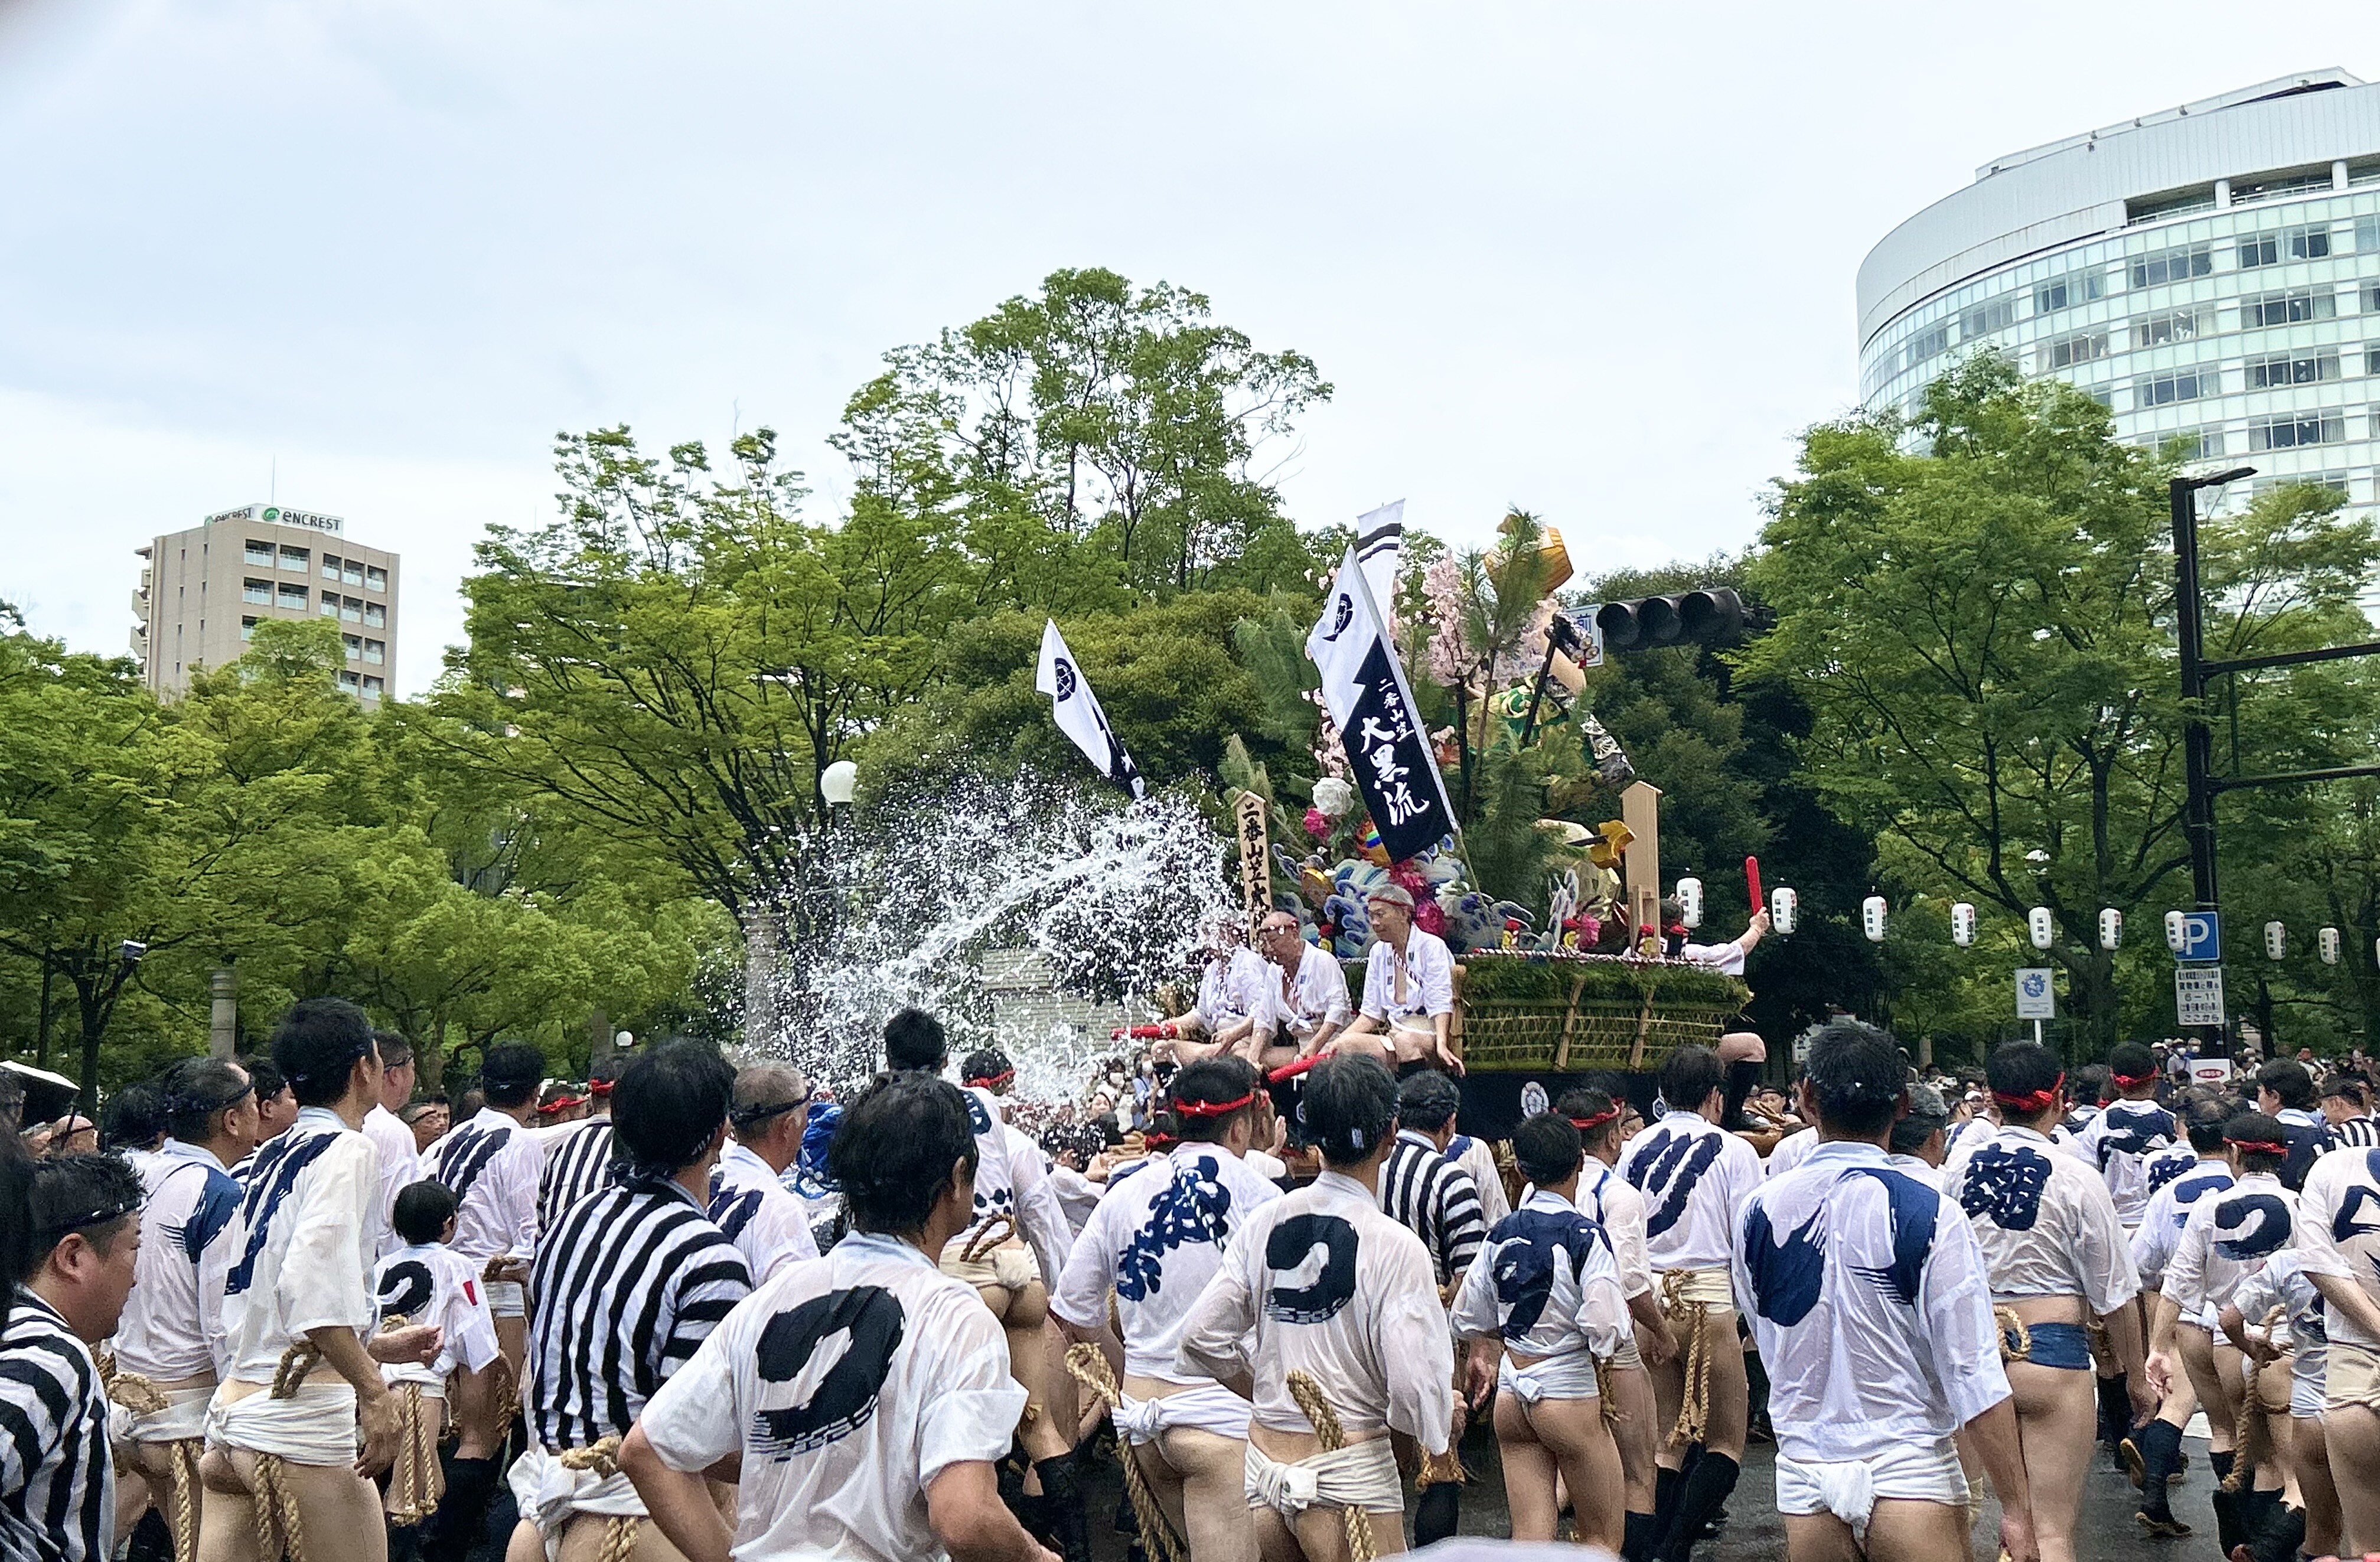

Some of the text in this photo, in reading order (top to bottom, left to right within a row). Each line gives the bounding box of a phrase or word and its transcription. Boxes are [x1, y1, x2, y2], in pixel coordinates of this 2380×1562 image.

[1378, 679, 1415, 742] 二番山笠
[1361, 716, 1430, 826] 大黒流
[2184, 918, 2209, 956] P
